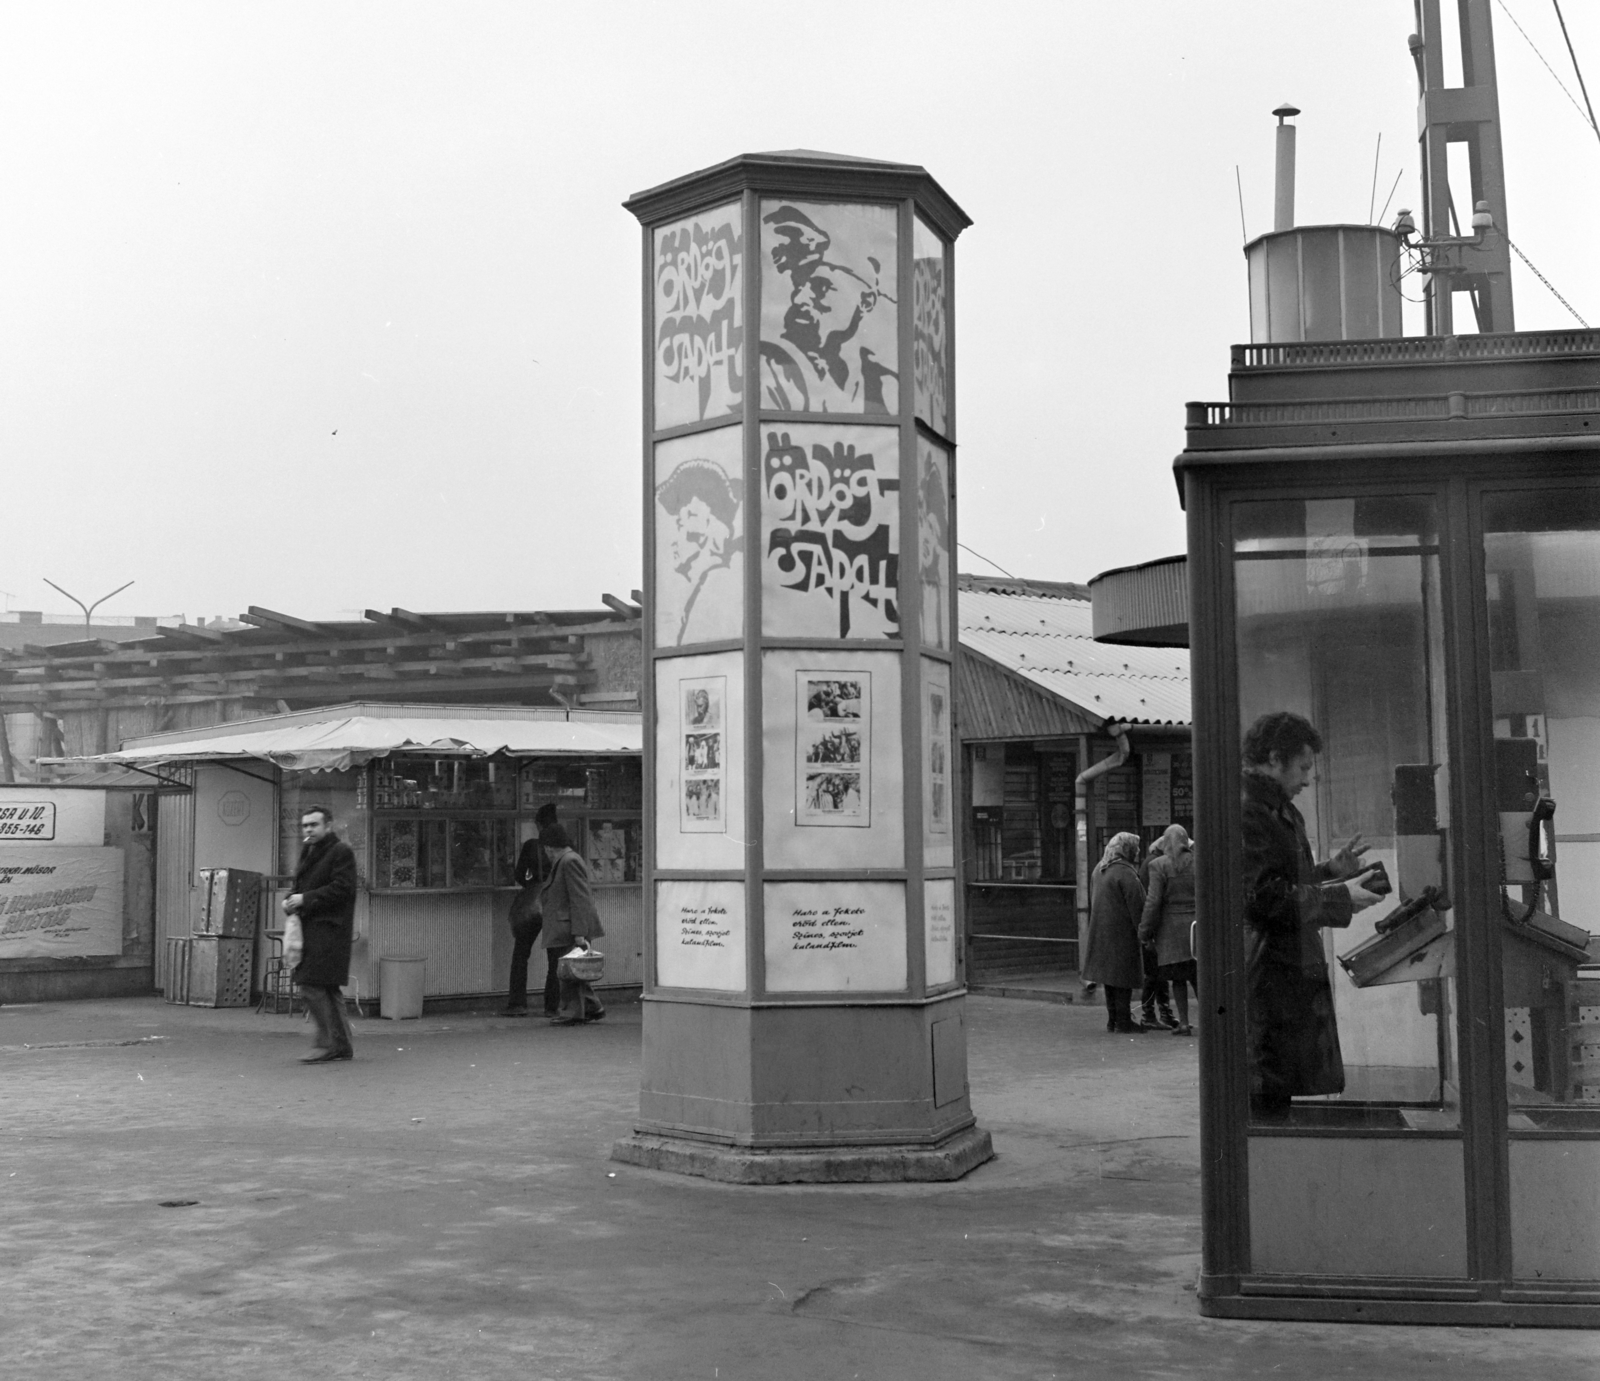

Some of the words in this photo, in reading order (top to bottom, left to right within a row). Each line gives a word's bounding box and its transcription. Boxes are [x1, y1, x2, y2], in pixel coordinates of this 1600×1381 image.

[792, 908, 819, 917] Harc
[833, 906, 866, 918] fekete
[821, 918, 851, 927] ellen.
[828, 928, 865, 939] szovjet
